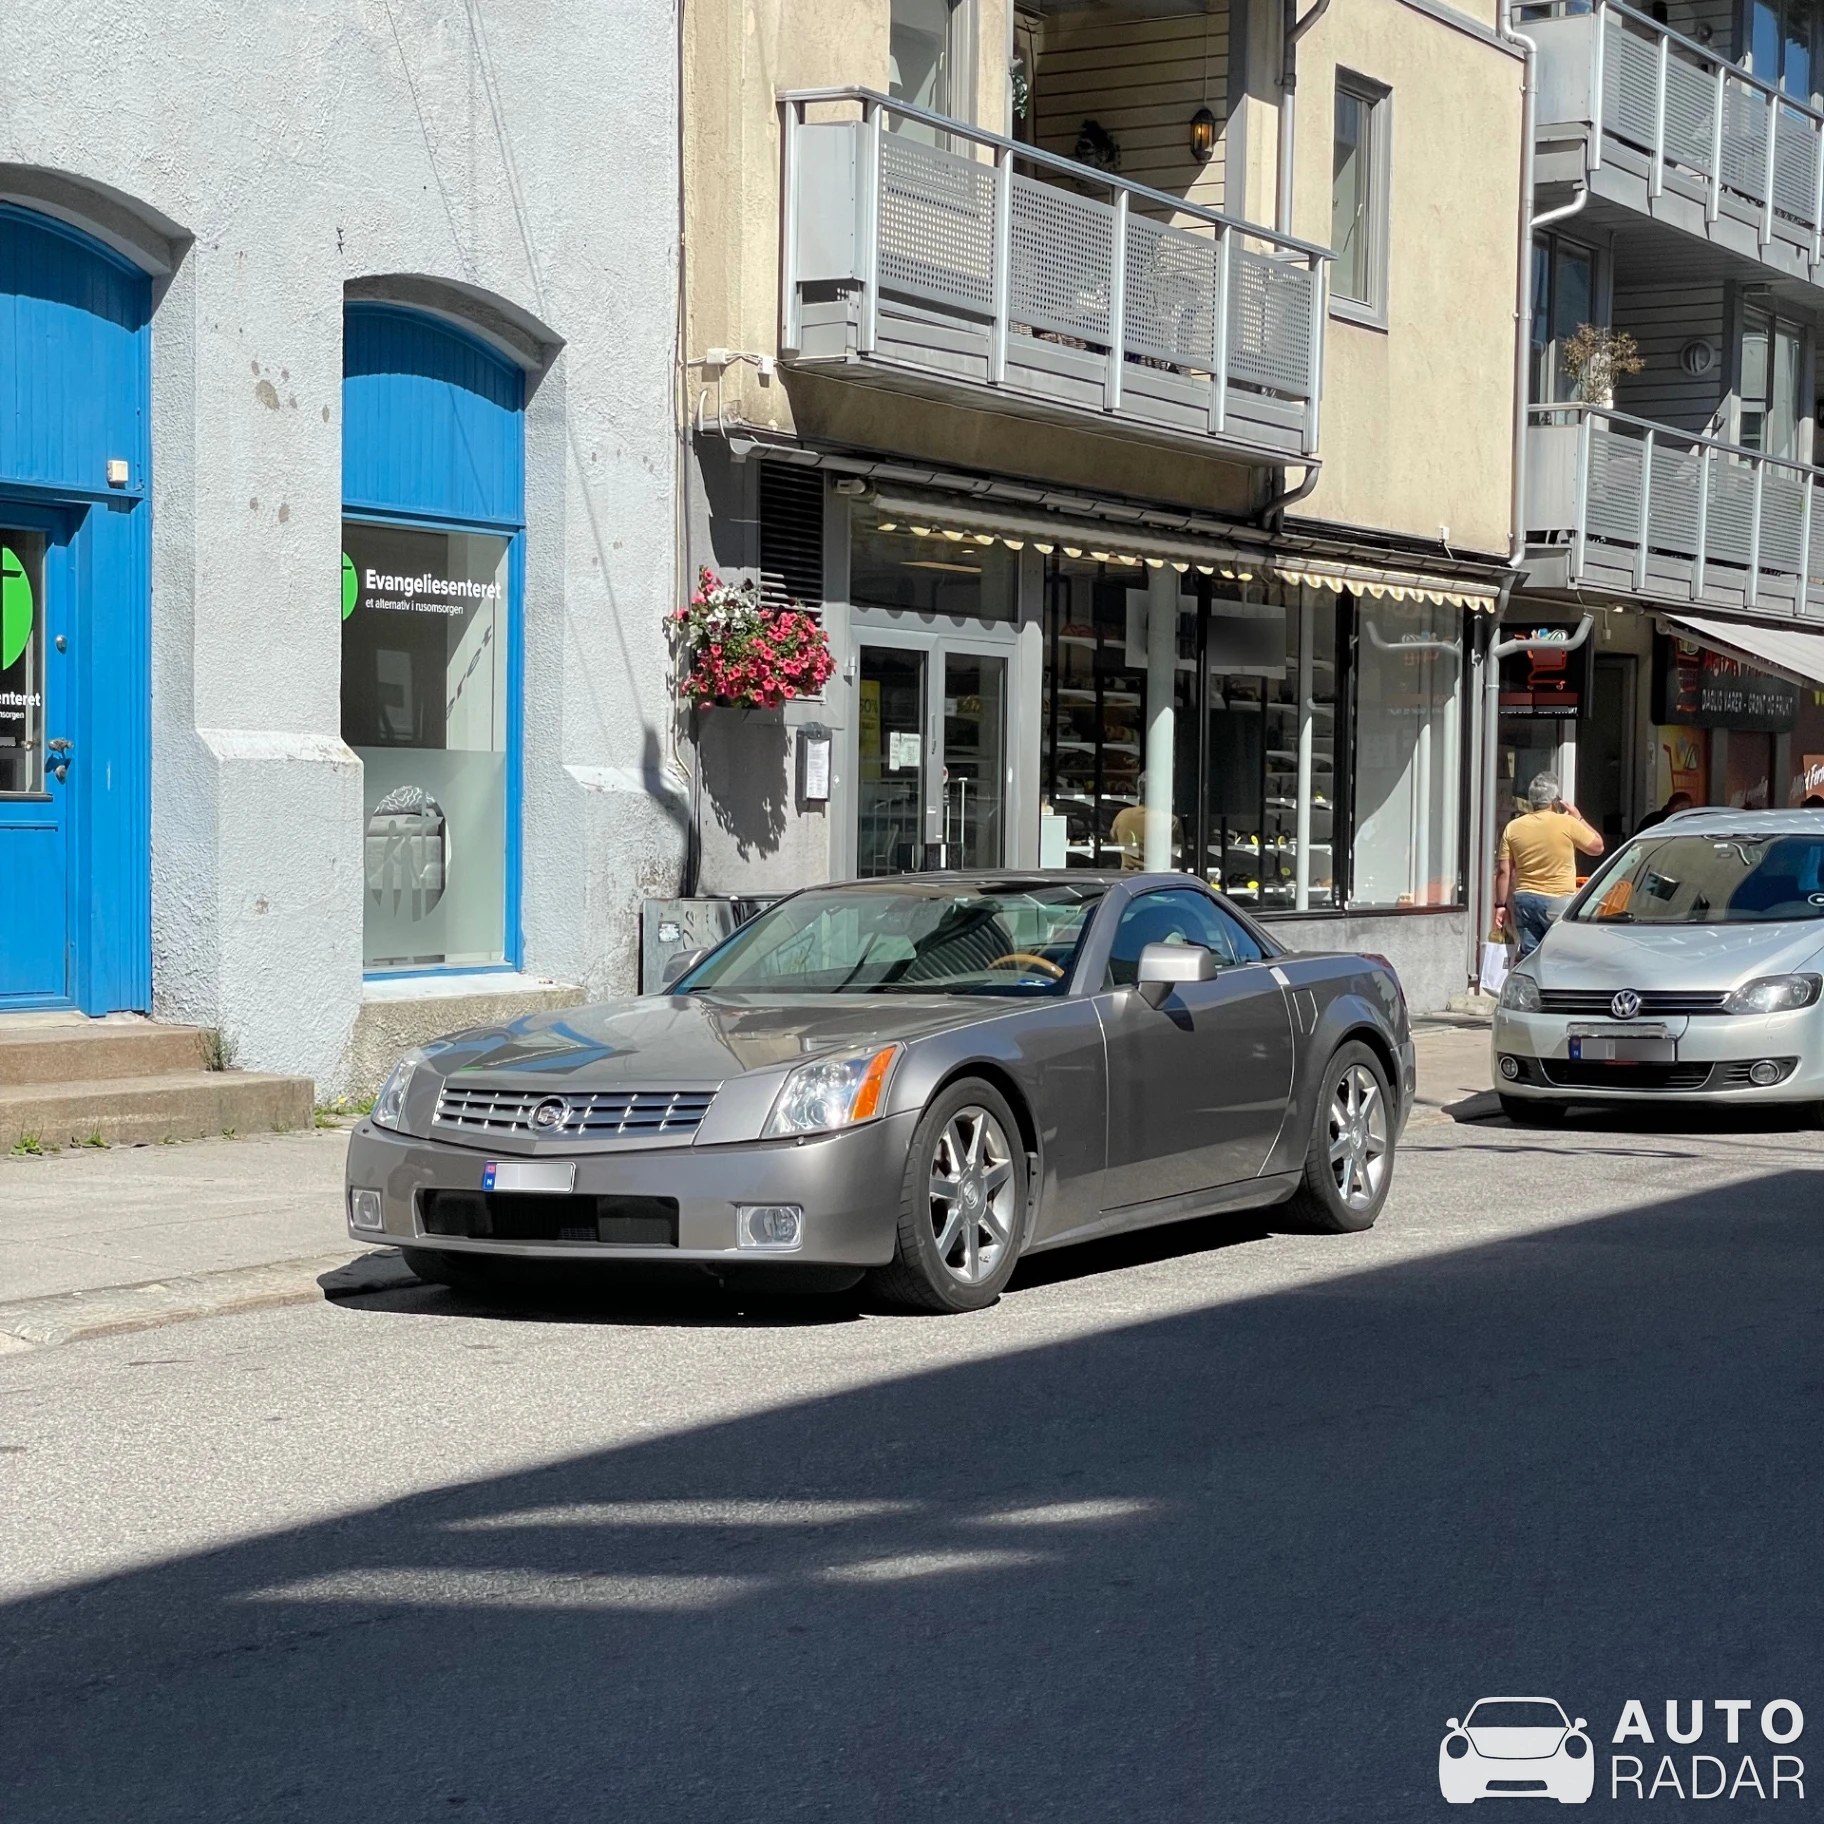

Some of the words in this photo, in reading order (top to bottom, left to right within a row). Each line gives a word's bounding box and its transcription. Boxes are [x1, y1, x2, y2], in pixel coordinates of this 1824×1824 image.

[366, 569, 502, 600] Evangeliesenteret
[365, 598, 374, 608] et
[375, 598, 411, 611] alternativ
[415, 602, 464, 617] rusomsorgen
[0, 691, 41, 707] nteret
